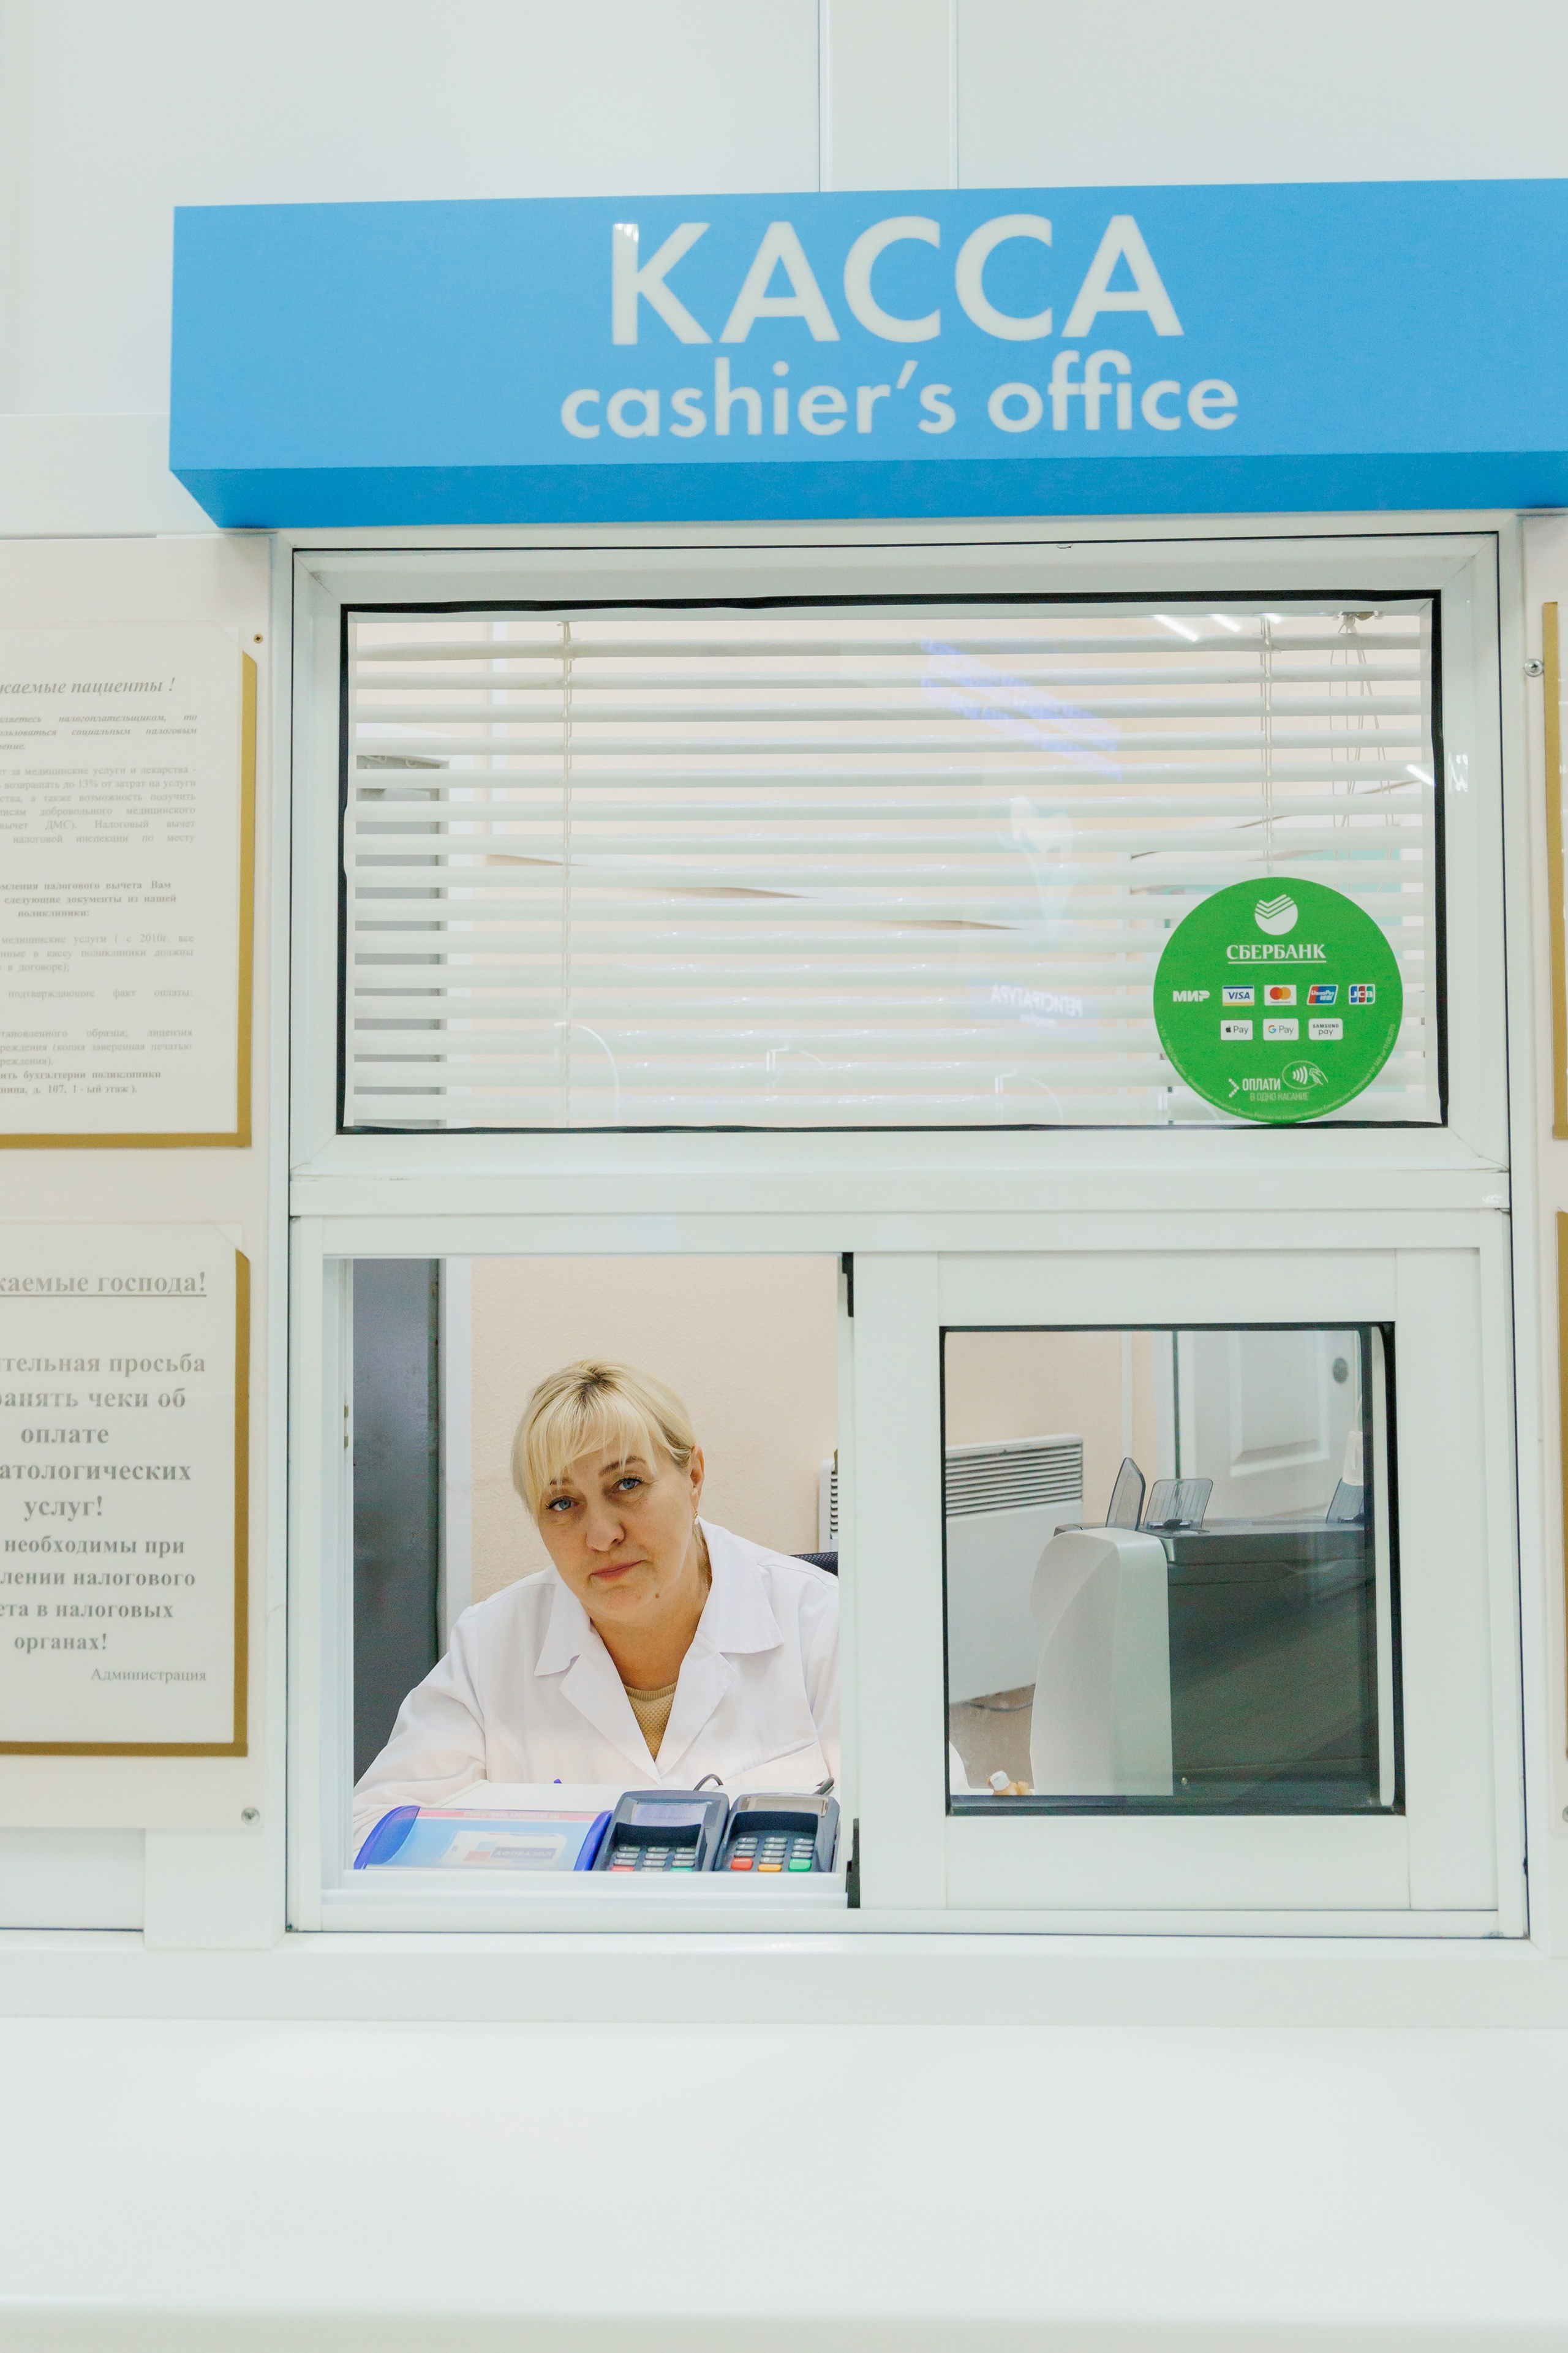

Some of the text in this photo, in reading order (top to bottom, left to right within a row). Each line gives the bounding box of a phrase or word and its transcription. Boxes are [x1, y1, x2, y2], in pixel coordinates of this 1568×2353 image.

[612, 214, 1185, 346] КАССА
[987, 350, 1238, 432] office
[71, 682, 162, 695] пациенты
[168, 677, 175, 692] !
[92, 768, 126, 777] услуги
[140, 767, 189, 776] лекарства
[4, 782, 60, 791] возвращать
[79, 779, 99, 788] 13%
[115, 781, 146, 790] затрат
[163, 780, 196, 789] услуги
[150, 794, 196, 803] получить
[39, 806, 113, 818] добровольного
[45, 820, 77, 830] ДМС).
[95, 820, 149, 828] Налоговый
[13, 834, 63, 844] налоговой
[167, 835, 195, 844] месту
[151, 880, 171, 889] Вам
[74, 937, 107, 945] услуги
[140, 934, 170, 943] 2010г.
[47, 951, 73, 959] кассу
[1226, 944, 1327, 960] СБЕРБАНК
[18, 963, 69, 973] договоре);
[9, 991, 94, 1000] подтверждающие
[113, 989, 136, 999] факт
[1173, 989, 1210, 1002] МИР
[1227, 991, 1251, 1000] VISA
[86, 1028, 128, 1039] образца;
[1233, 1025, 1249, 1035] Pay
[1278, 1025, 1294, 1035] Pay
[91, 1044, 145, 1052] заверенная
[23, 1071, 86, 1081] бухгалтерии
[48, 1084, 66, 1093] 107,
[1242, 1078, 1281, 1090] ОПЛАТИ
[1250, 1092, 1255, 1101] В
[98, 1272, 205, 1294] господа!
[0, 1353, 205, 1377] тельная просьба
[89, 1393, 148, 1407] чеки
[158, 1388, 185, 1407] об
[21, 1429, 108, 1443] оплате
[24, 1496, 102, 1522] услуг!
[5, 1536, 184, 1558] необходимы при
[74, 1574, 195, 1585] налогового
[37, 1605, 48, 1617] в
[56, 1605, 172, 1617] налоговых
[14, 1633, 106, 1654] органах!
[91, 1668, 206, 1684] Администрация
